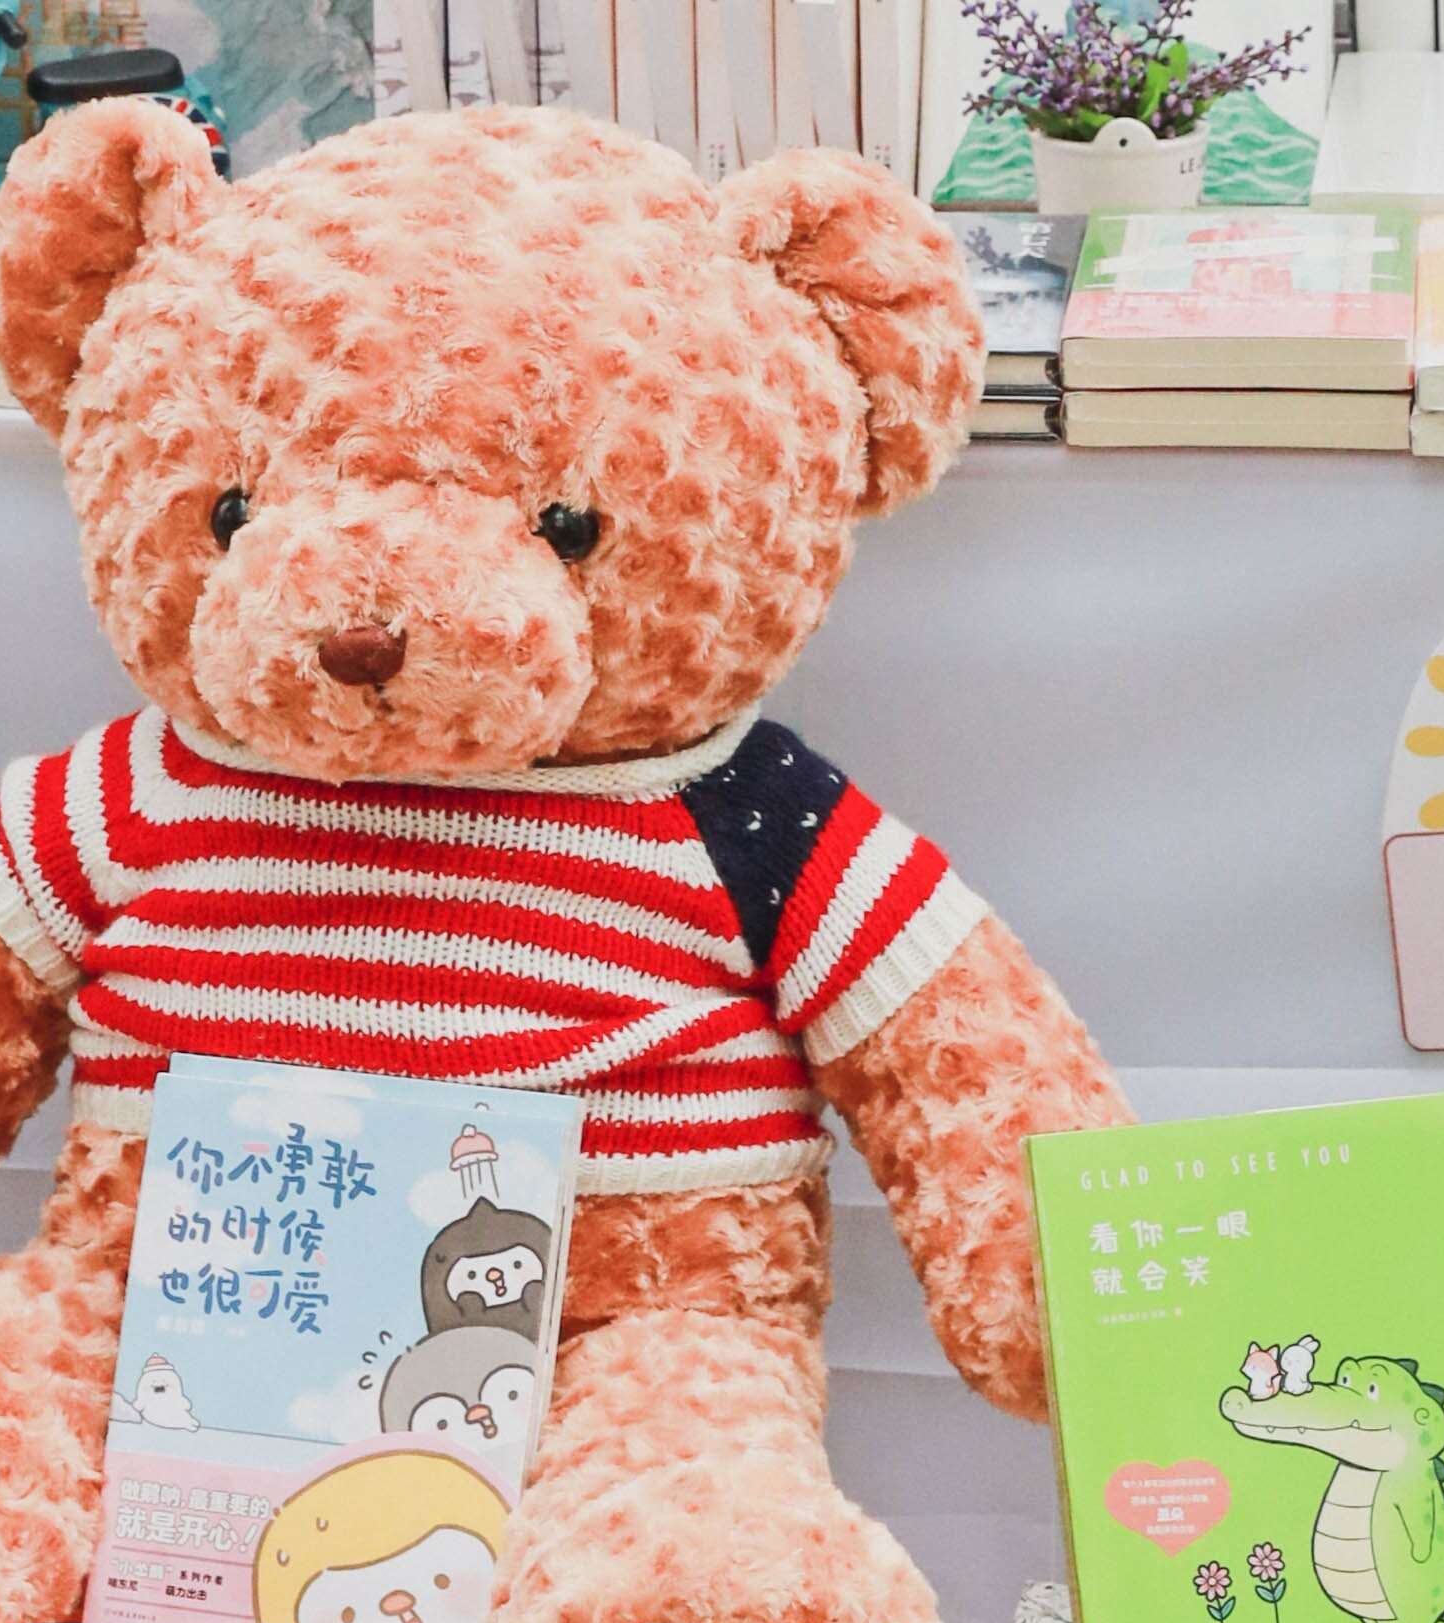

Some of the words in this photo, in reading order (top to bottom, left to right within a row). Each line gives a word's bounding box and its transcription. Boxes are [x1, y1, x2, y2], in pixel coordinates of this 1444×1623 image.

[168, 1124, 377, 1208] 你不勇敢
[1081, 1164, 1150, 1191] GLAD
[1174, 1160, 1205, 1182] TO
[1231, 1151, 1278, 1175] SEE
[1302, 1144, 1352, 1168] YOU
[168, 1206, 325, 1262] 的时候
[1090, 1210, 1251, 1254] 看你一眼
[159, 1264, 330, 1334] 也很可爱
[1092, 1256, 1212, 1296] 就会笑
